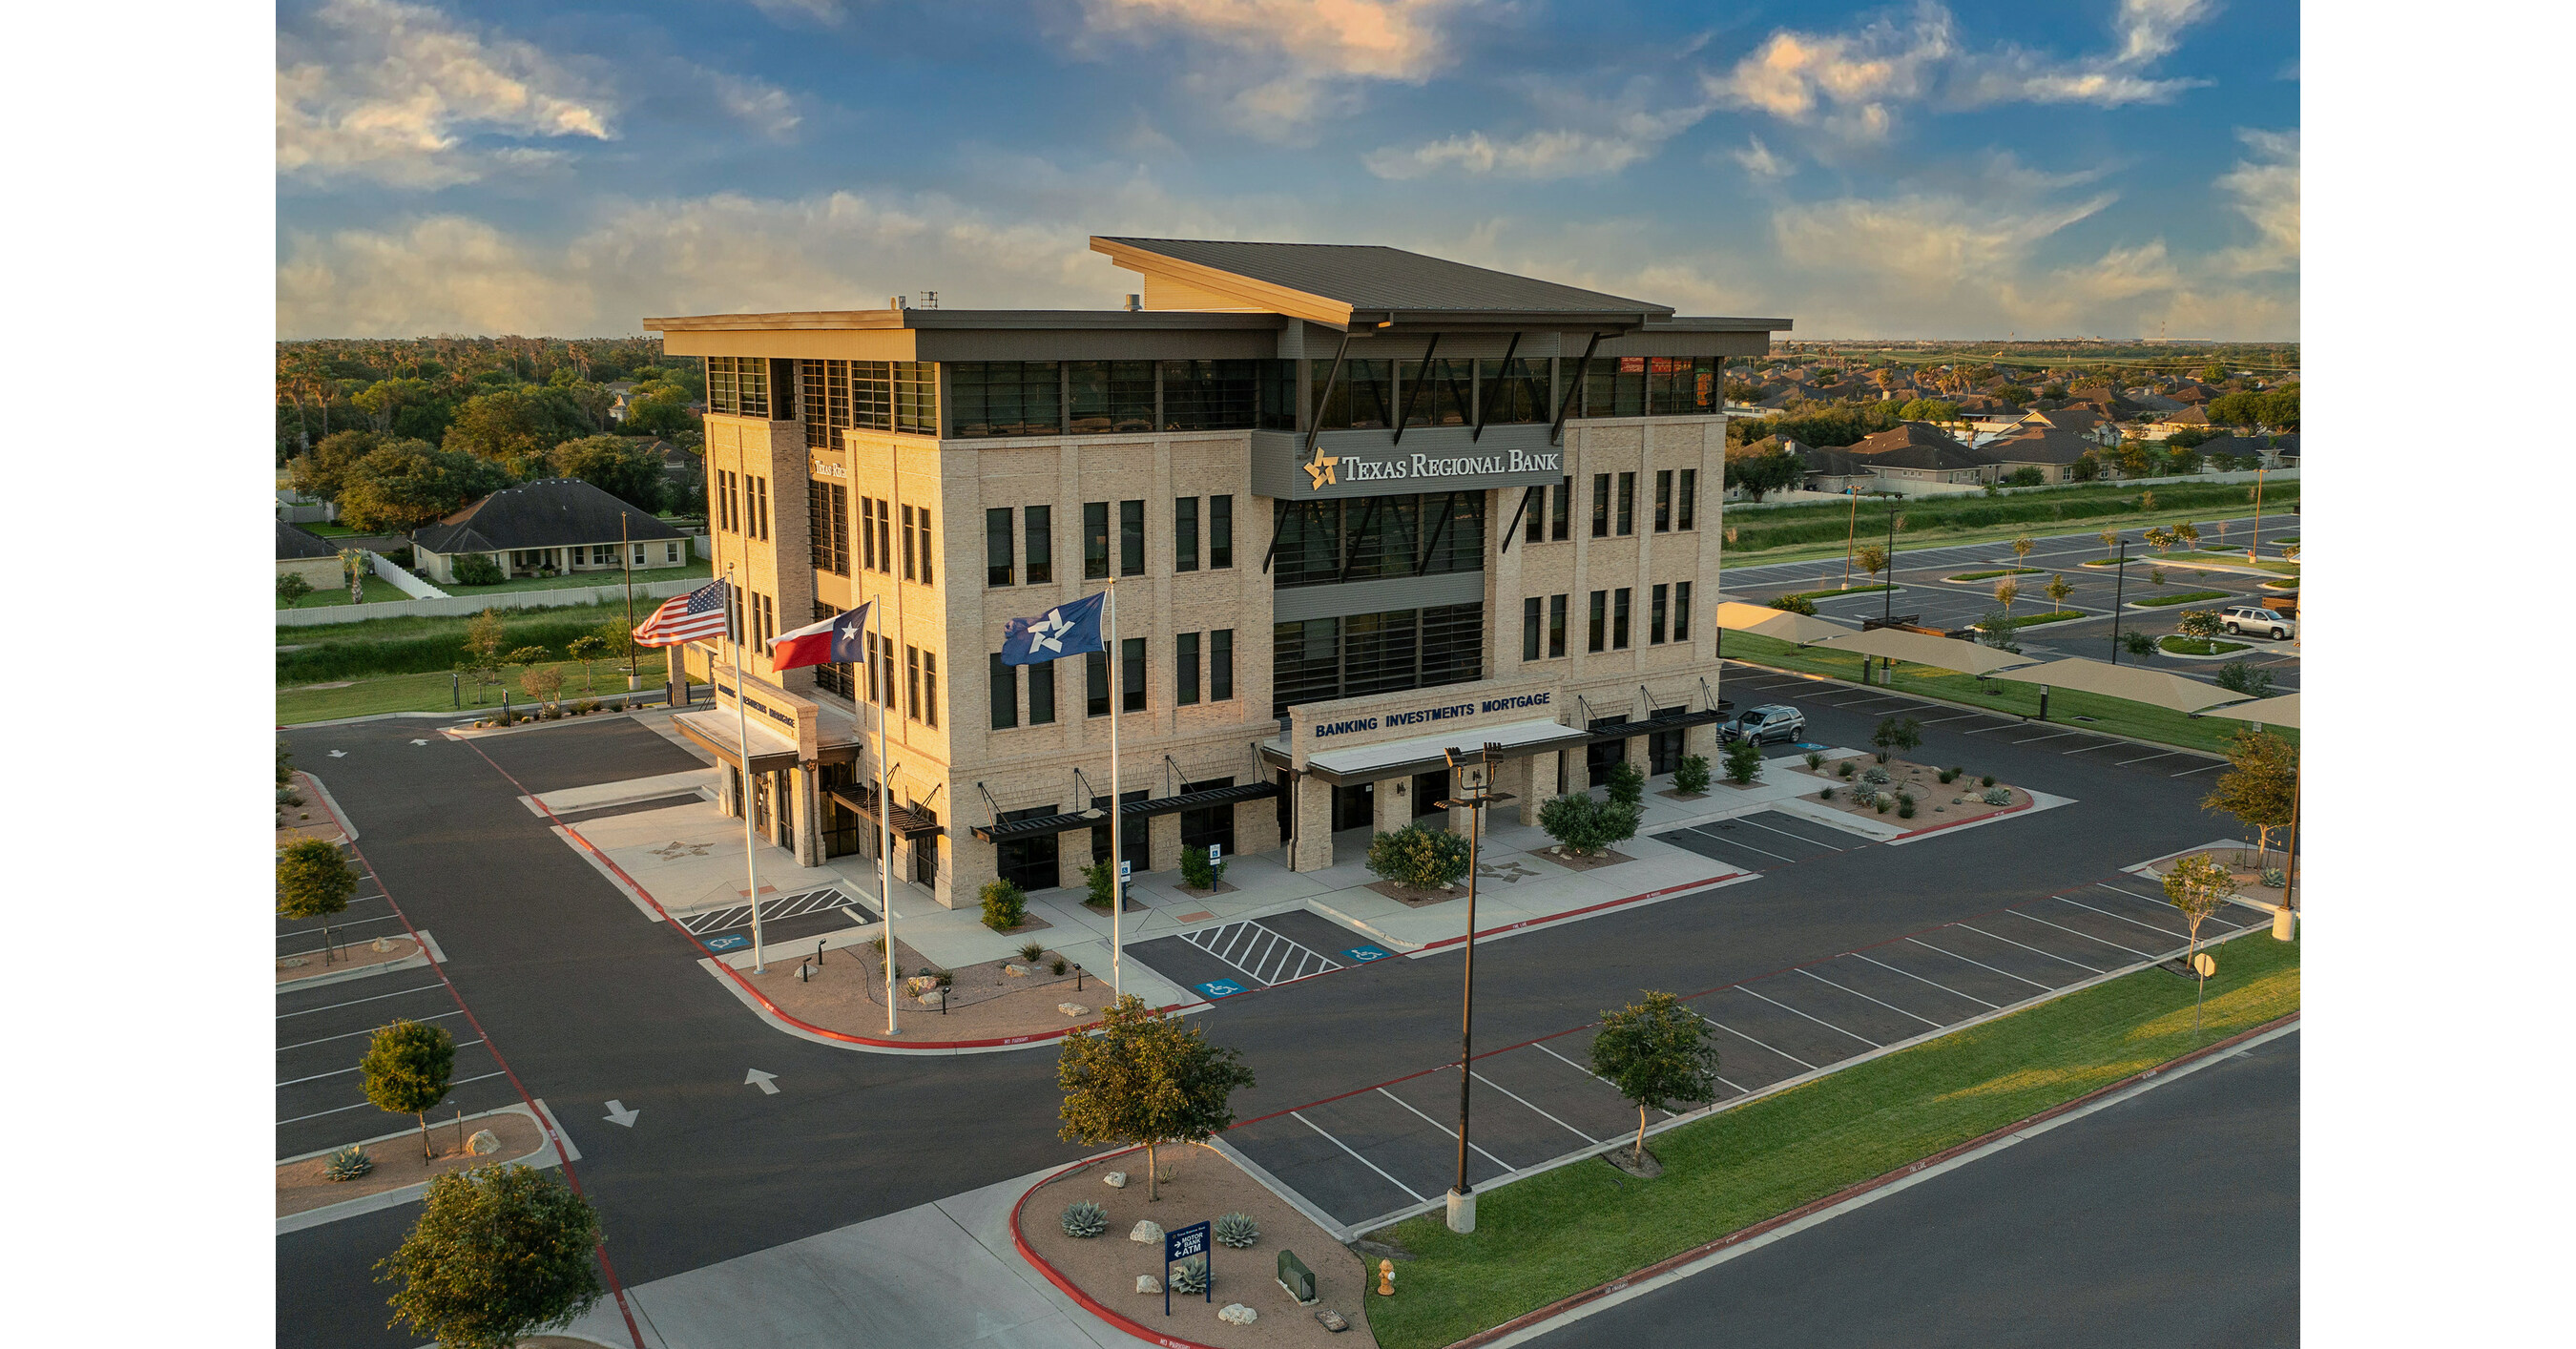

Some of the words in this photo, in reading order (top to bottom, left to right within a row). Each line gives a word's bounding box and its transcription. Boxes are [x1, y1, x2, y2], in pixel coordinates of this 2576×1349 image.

[1341, 456, 1406, 481] TEXAS
[1410, 453, 1505, 478] REGIONAL
[1507, 449, 1559, 472] BANK
[1316, 717, 1378, 737] BANKING
[1385, 703, 1475, 728] INVESTMENTS
[1482, 692, 1550, 714] MORTGAGE
[1181, 1232, 1204, 1244] MOTOR
[1184, 1239, 1201, 1248] BANK
[1182, 1243, 1202, 1256] ATM
[1160, 1338, 1168, 1346] NO
